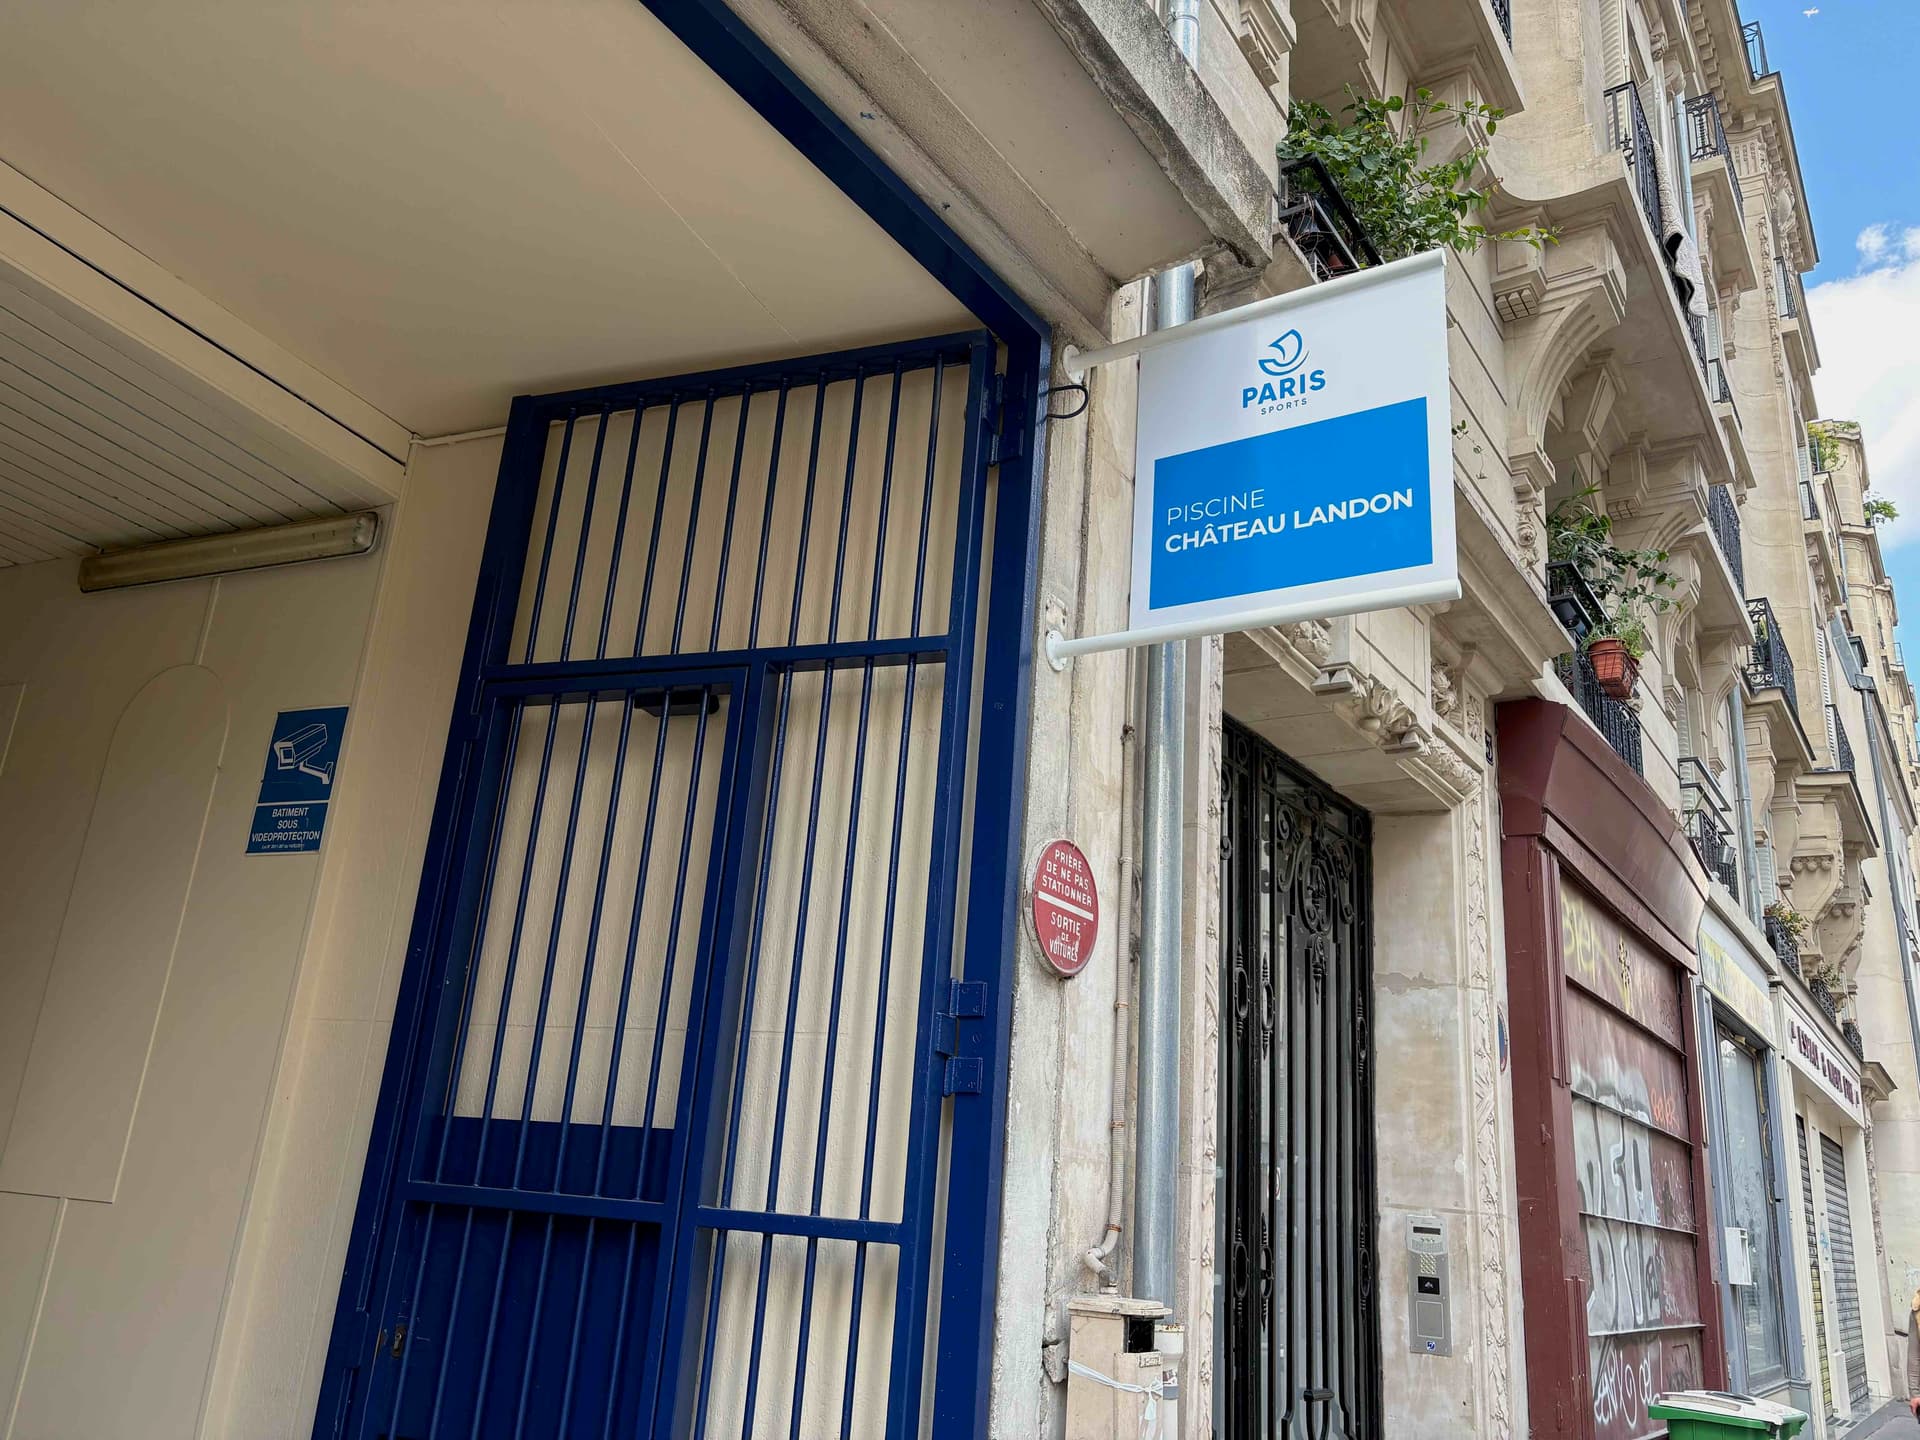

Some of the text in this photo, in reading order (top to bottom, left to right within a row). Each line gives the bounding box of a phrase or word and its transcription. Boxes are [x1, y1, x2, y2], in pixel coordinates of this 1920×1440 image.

[1242, 369, 1326, 409] PARIS
[1260, 397, 1308, 416] SPORTS
[1167, 488, 1265, 526] PISCINE
[1165, 488, 1414, 553] CHÂTEAU LANDON
[272, 807, 309, 818] BATIMENT
[277, 819, 298, 829] SOUS
[252, 830, 320, 842] VIDEOPROTECTION
[1055, 848, 1082, 873] PRIÈRE
[1046, 860, 1089, 891] DE NE PAS
[1042, 874, 1092, 908] STATIONNER
[1050, 911, 1081, 936] SORTIE
[1049, 936, 1079, 963] VOITURES
[1060, 932, 1070, 943] DE
